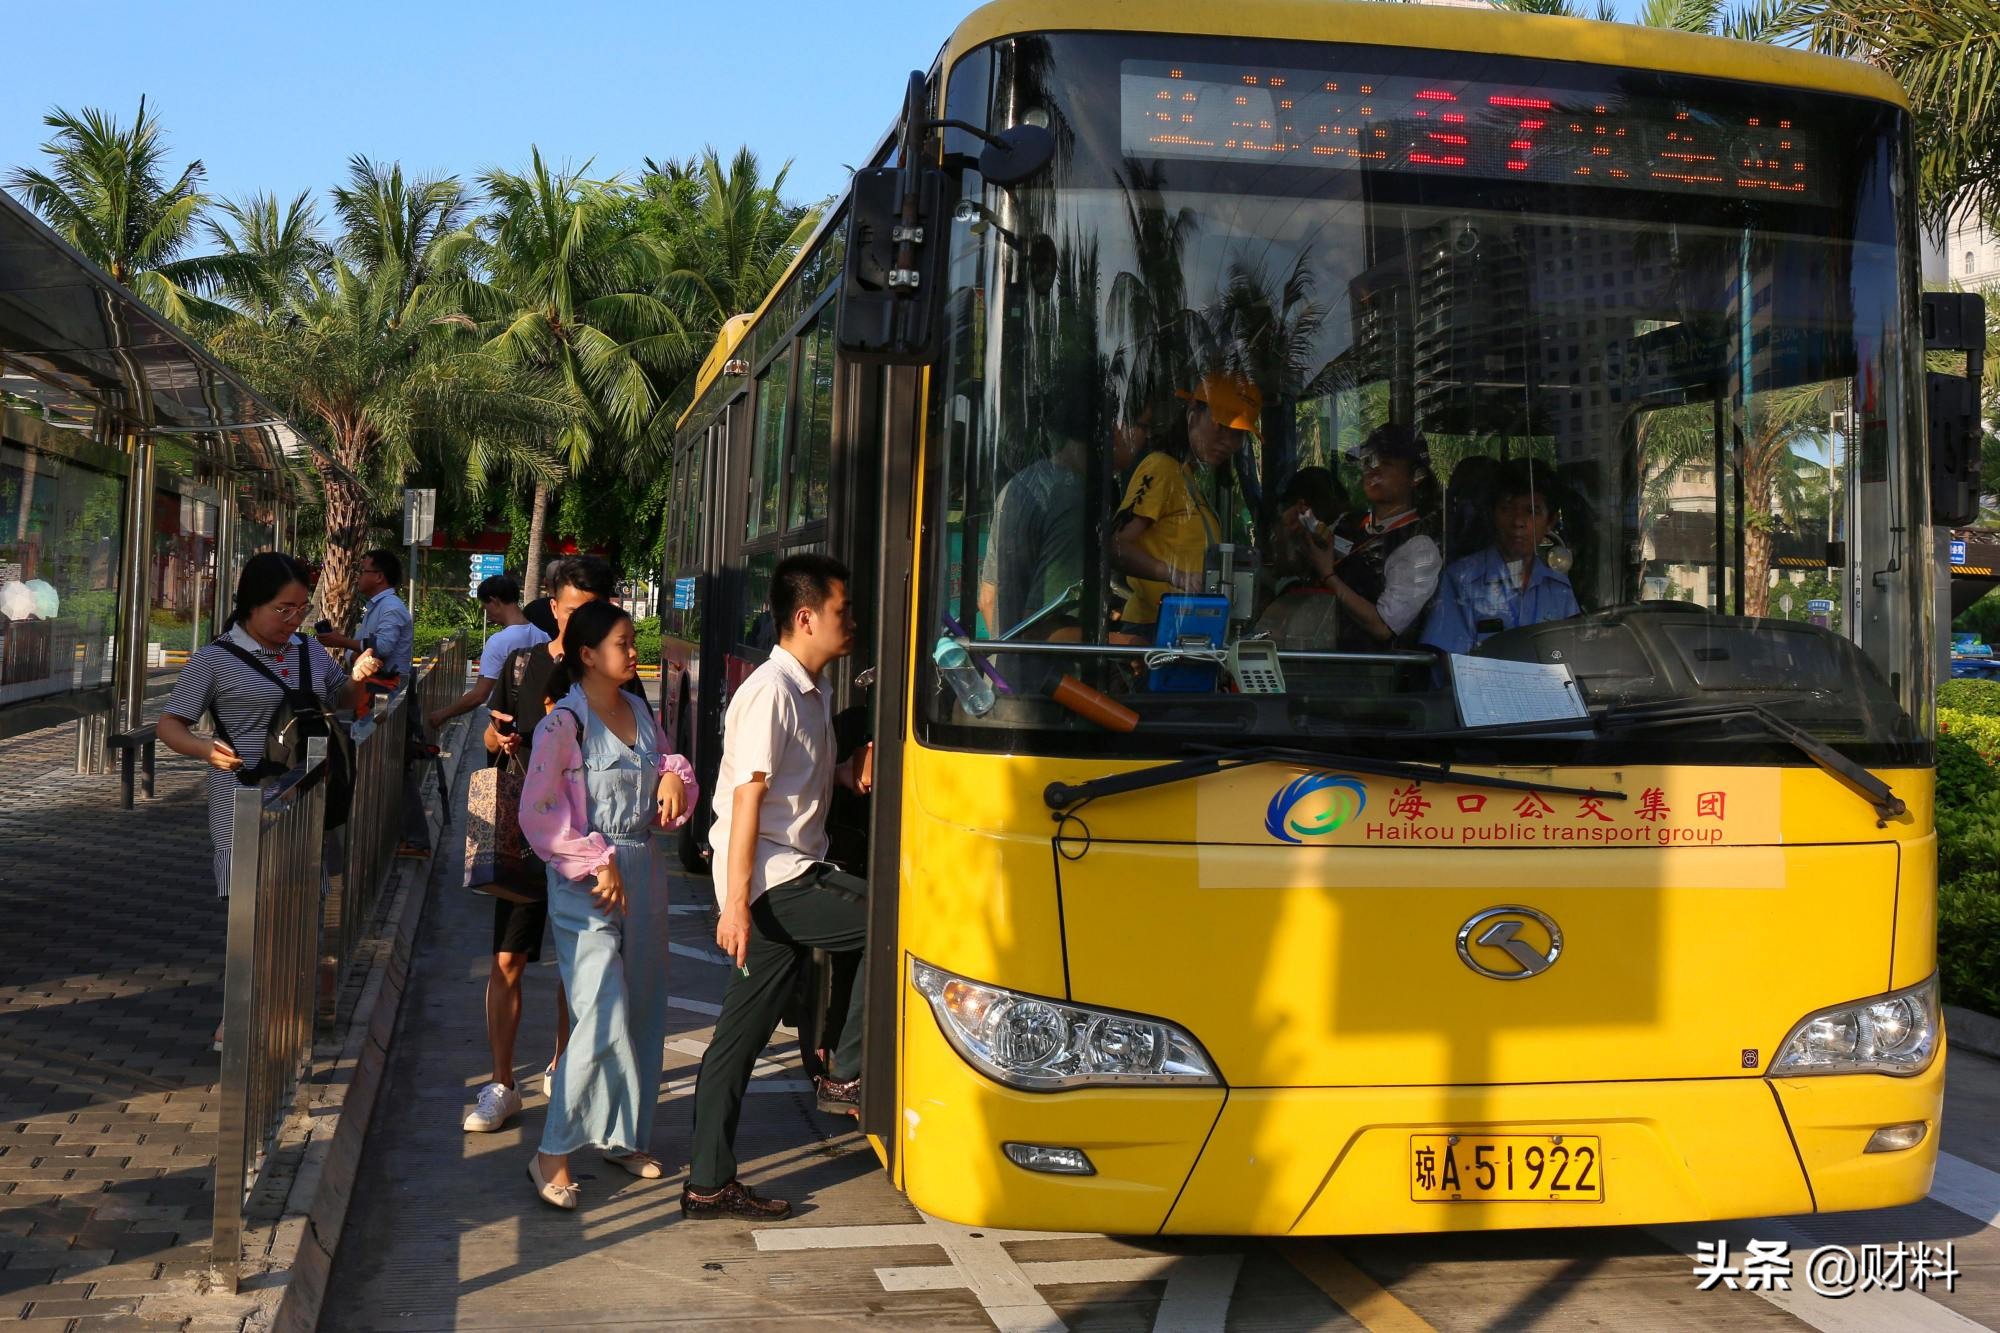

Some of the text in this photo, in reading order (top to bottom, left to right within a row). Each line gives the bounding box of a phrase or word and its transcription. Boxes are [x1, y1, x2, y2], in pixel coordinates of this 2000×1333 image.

[1389, 784, 1726, 822] 海口公交集团
[1366, 823, 1723, 845] Haikou public transport group
